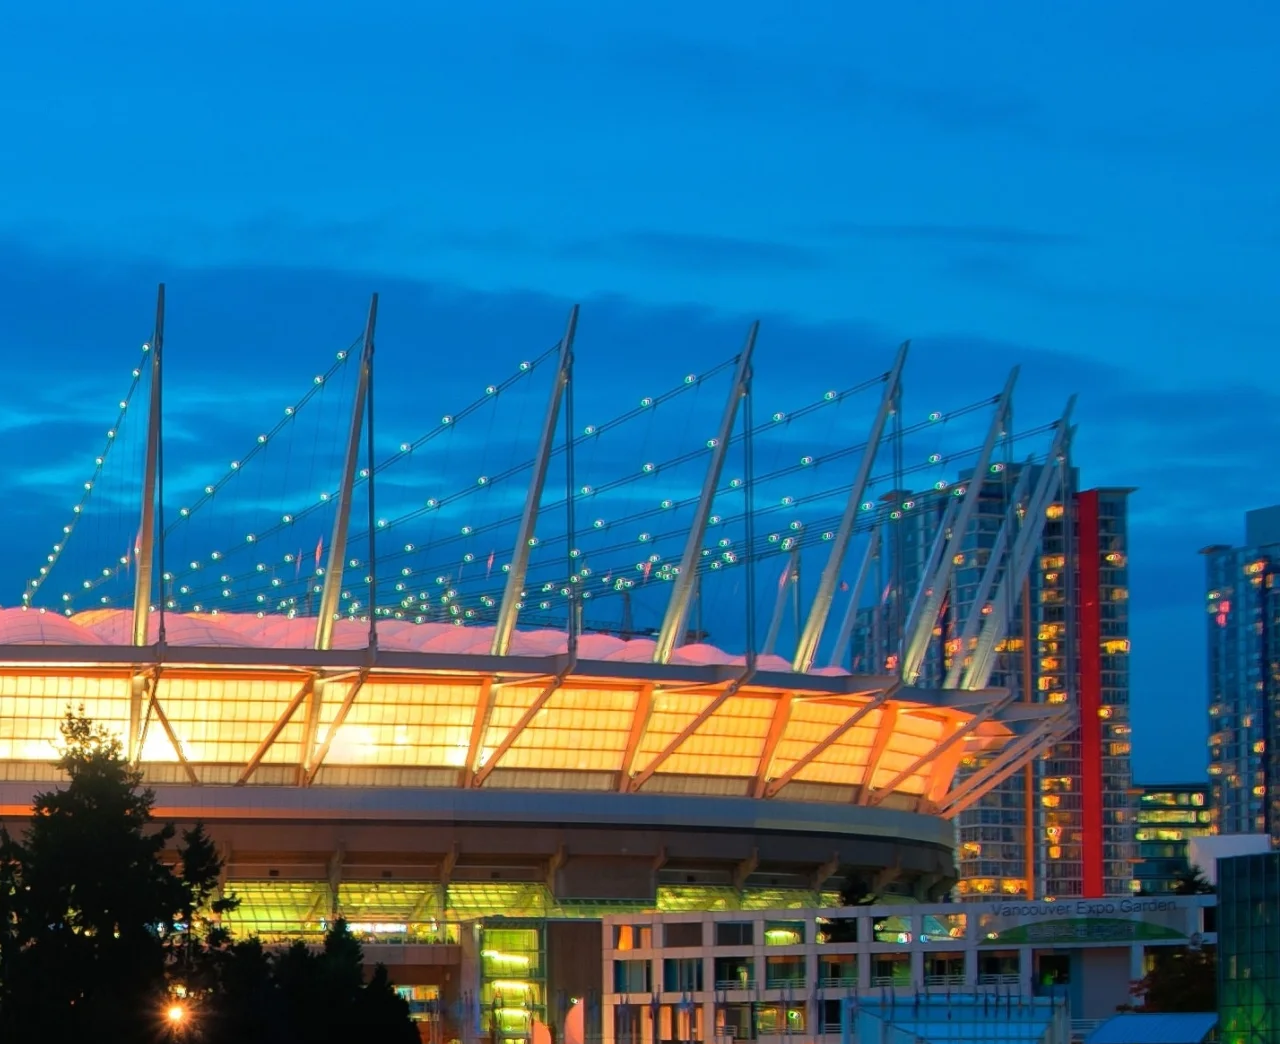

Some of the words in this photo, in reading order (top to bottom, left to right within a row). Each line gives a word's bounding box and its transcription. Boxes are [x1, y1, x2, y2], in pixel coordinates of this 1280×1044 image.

[991, 903, 1071, 917] Vancouver
[1076, 901, 1115, 915] Expo
[1120, 899, 1177, 913] Garden
